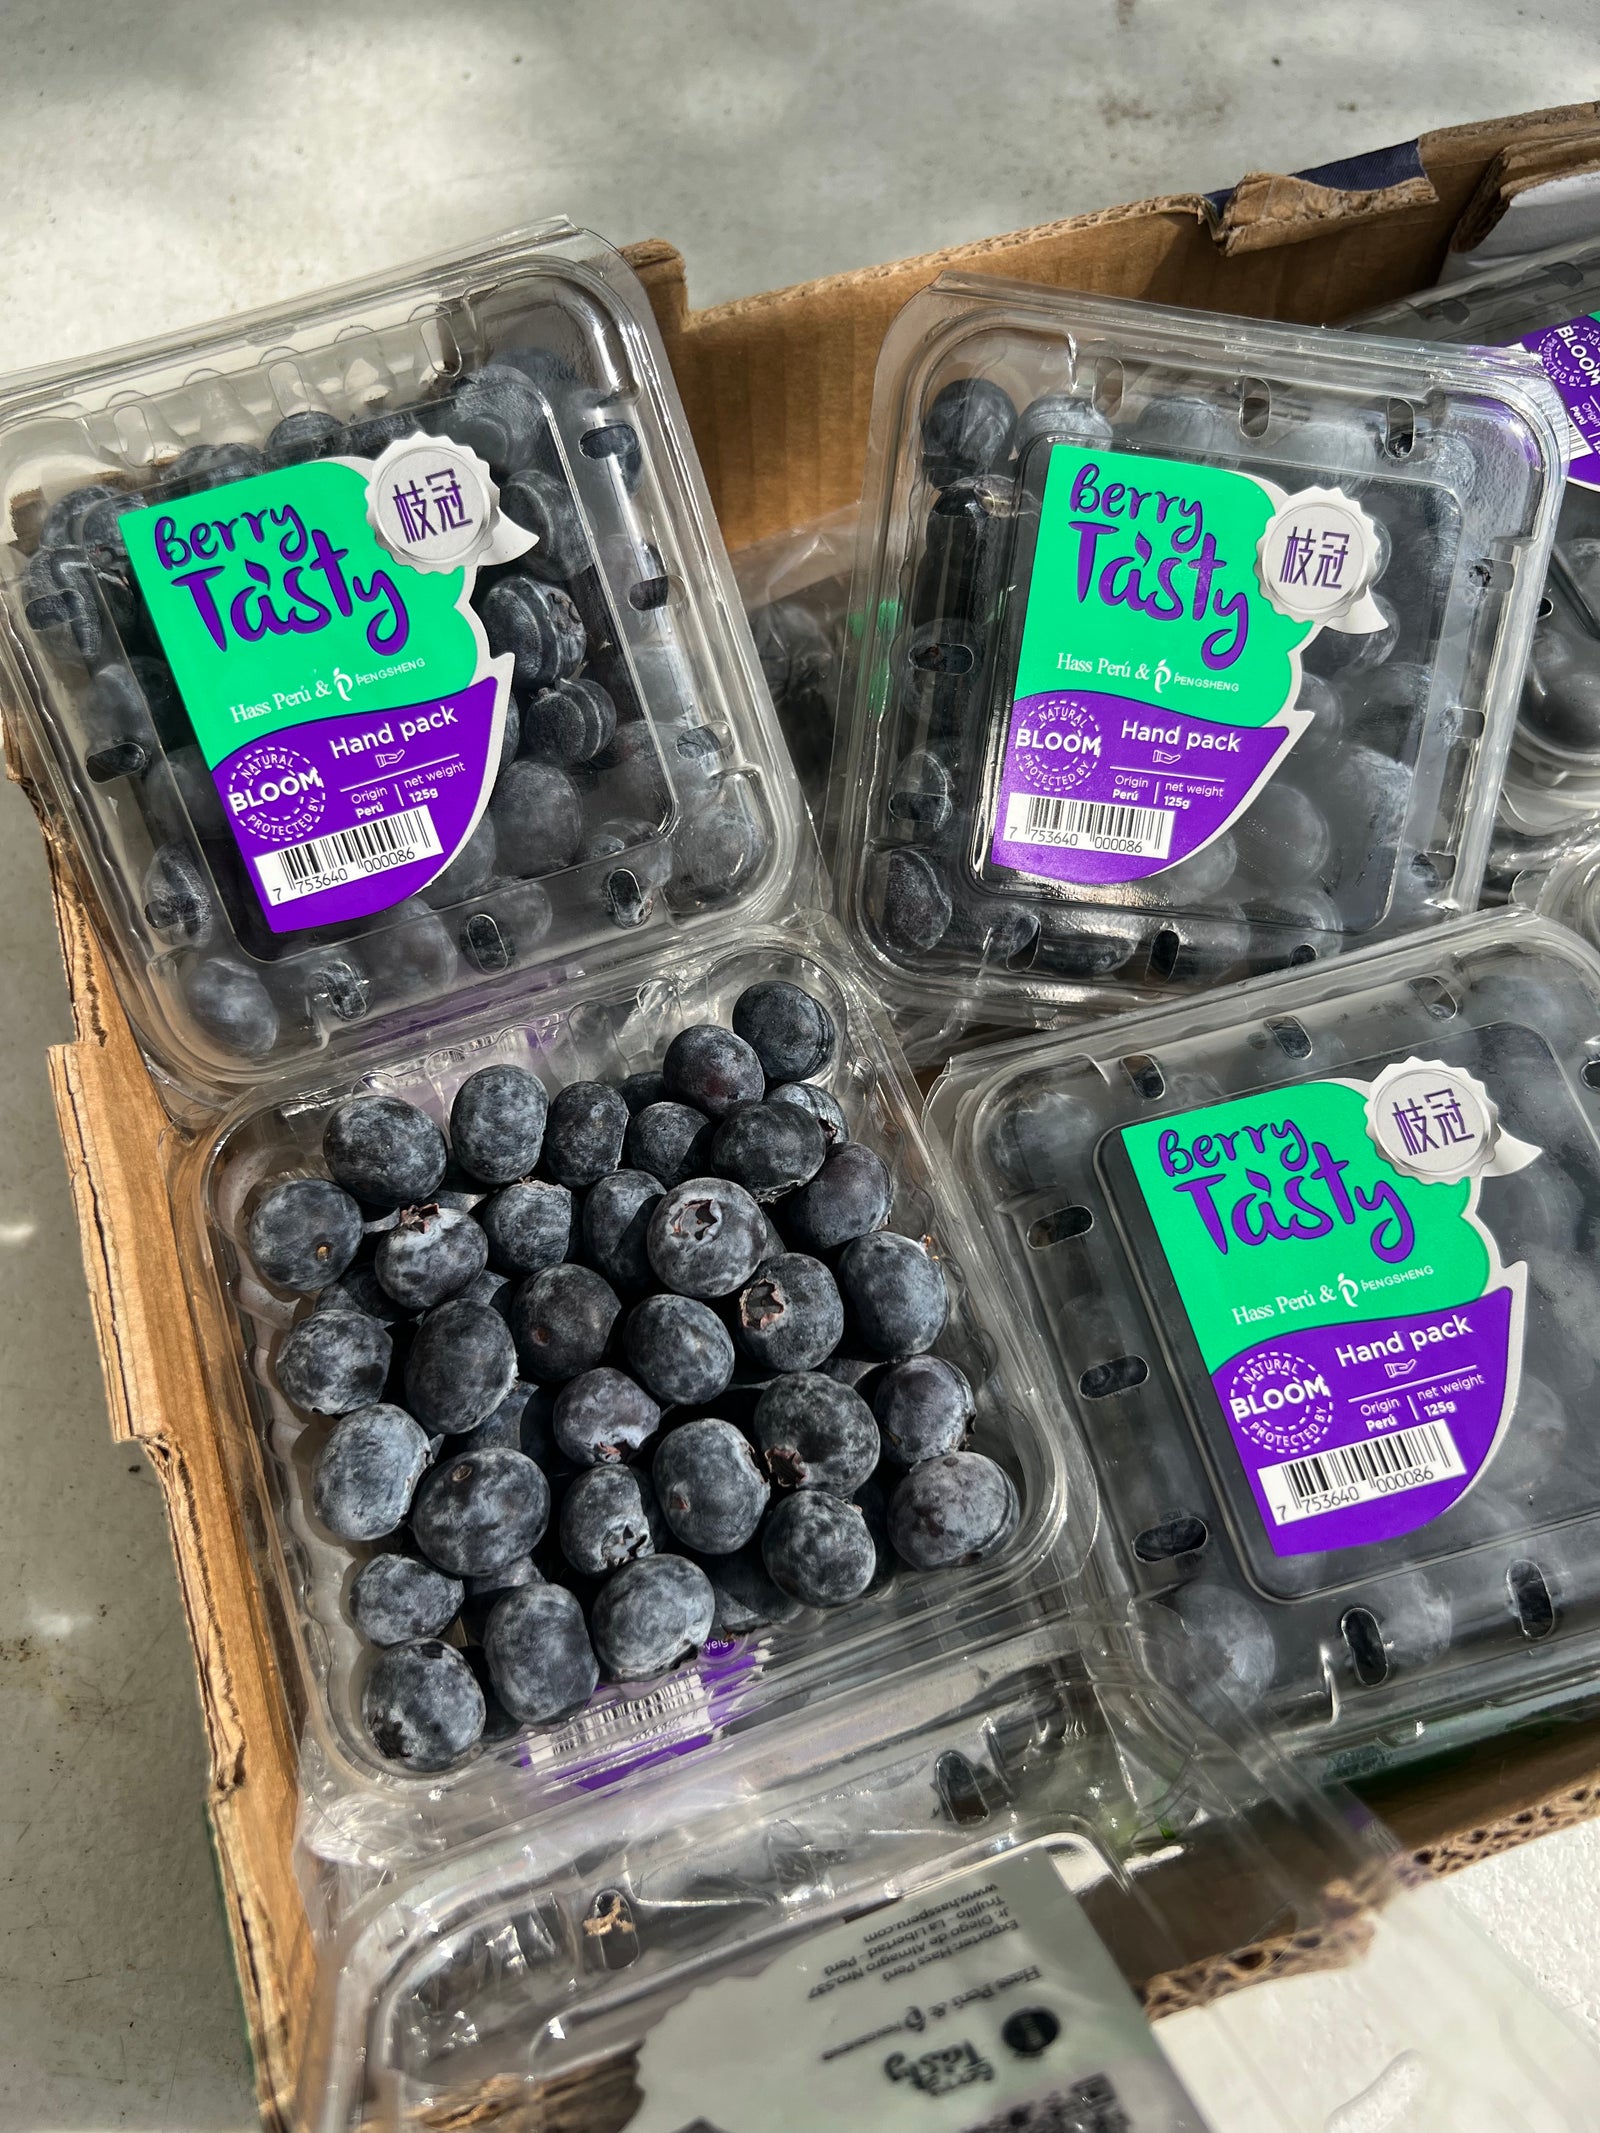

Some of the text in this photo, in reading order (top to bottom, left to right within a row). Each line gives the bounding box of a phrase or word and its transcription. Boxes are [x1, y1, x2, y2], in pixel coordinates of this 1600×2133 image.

[1557, 325, 1600, 387] BLOOM
[1569, 375, 1581, 384] BY
[392, 468, 474, 544] 枝冠
[1069, 463, 1203, 553] Berry
[154, 502, 309, 571] Berry
[1279, 525, 1351, 590] 枝冠
[1056, 653, 1240, 693] Hass Perú & PENGSHENG
[230, 658, 426, 725] Hass Perú & PENGSHENG
[1038, 706, 1089, 728] NATURAL
[329, 706, 459, 759] Hand pack
[1016, 727, 1100, 756] BLOOM
[1121, 720, 1241, 754] Hand pack
[241, 752, 294, 779] NATURAL
[404, 760, 466, 788] net weight
[1022, 754, 1089, 786] PROTECTED BY
[227, 767, 323, 815] BLOOM
[351, 784, 389, 806] Origin
[409, 787, 438, 805] 125g
[1113, 788, 1139, 802] Perú
[1115, 774, 1149, 790] Origin
[1165, 782, 1224, 798] net weight
[248, 796, 320, 836] PROTECTED BY
[356, 801, 385, 819] Perú
[1164, 795, 1190, 810] 125g
[1008, 825, 1143, 854] 7 753640 000086
[272, 848, 416, 901] 7 753640 000086
[1392, 1088, 1474, 1156] 枝冠
[1157, 1119, 1309, 1176] Berry
[1232, 1264, 1434, 1325] Hass Perú & PENGSHENG
[1335, 1313, 1474, 1367] Hand pack
[1241, 1358, 1298, 1385] NATURAL
[1416, 1372, 1485, 1400] net weight
[1228, 1375, 1332, 1421] BLOOM
[1360, 1397, 1400, 1417] Origin
[1423, 1399, 1457, 1416] 125g
[1250, 1405, 1327, 1447] PROTECTED BY
[1366, 1414, 1399, 1432] Perú
[1276, 1465, 1434, 1521] 7 753640 000086
[956, 1897, 1005, 1920] Trujillo
[950, 1915, 992, 1937] Diego
[867, 1926, 926, 1957] Libertad
[866, 1943, 925, 1972] Almagro
[917, 1947, 951, 1968] Hass
